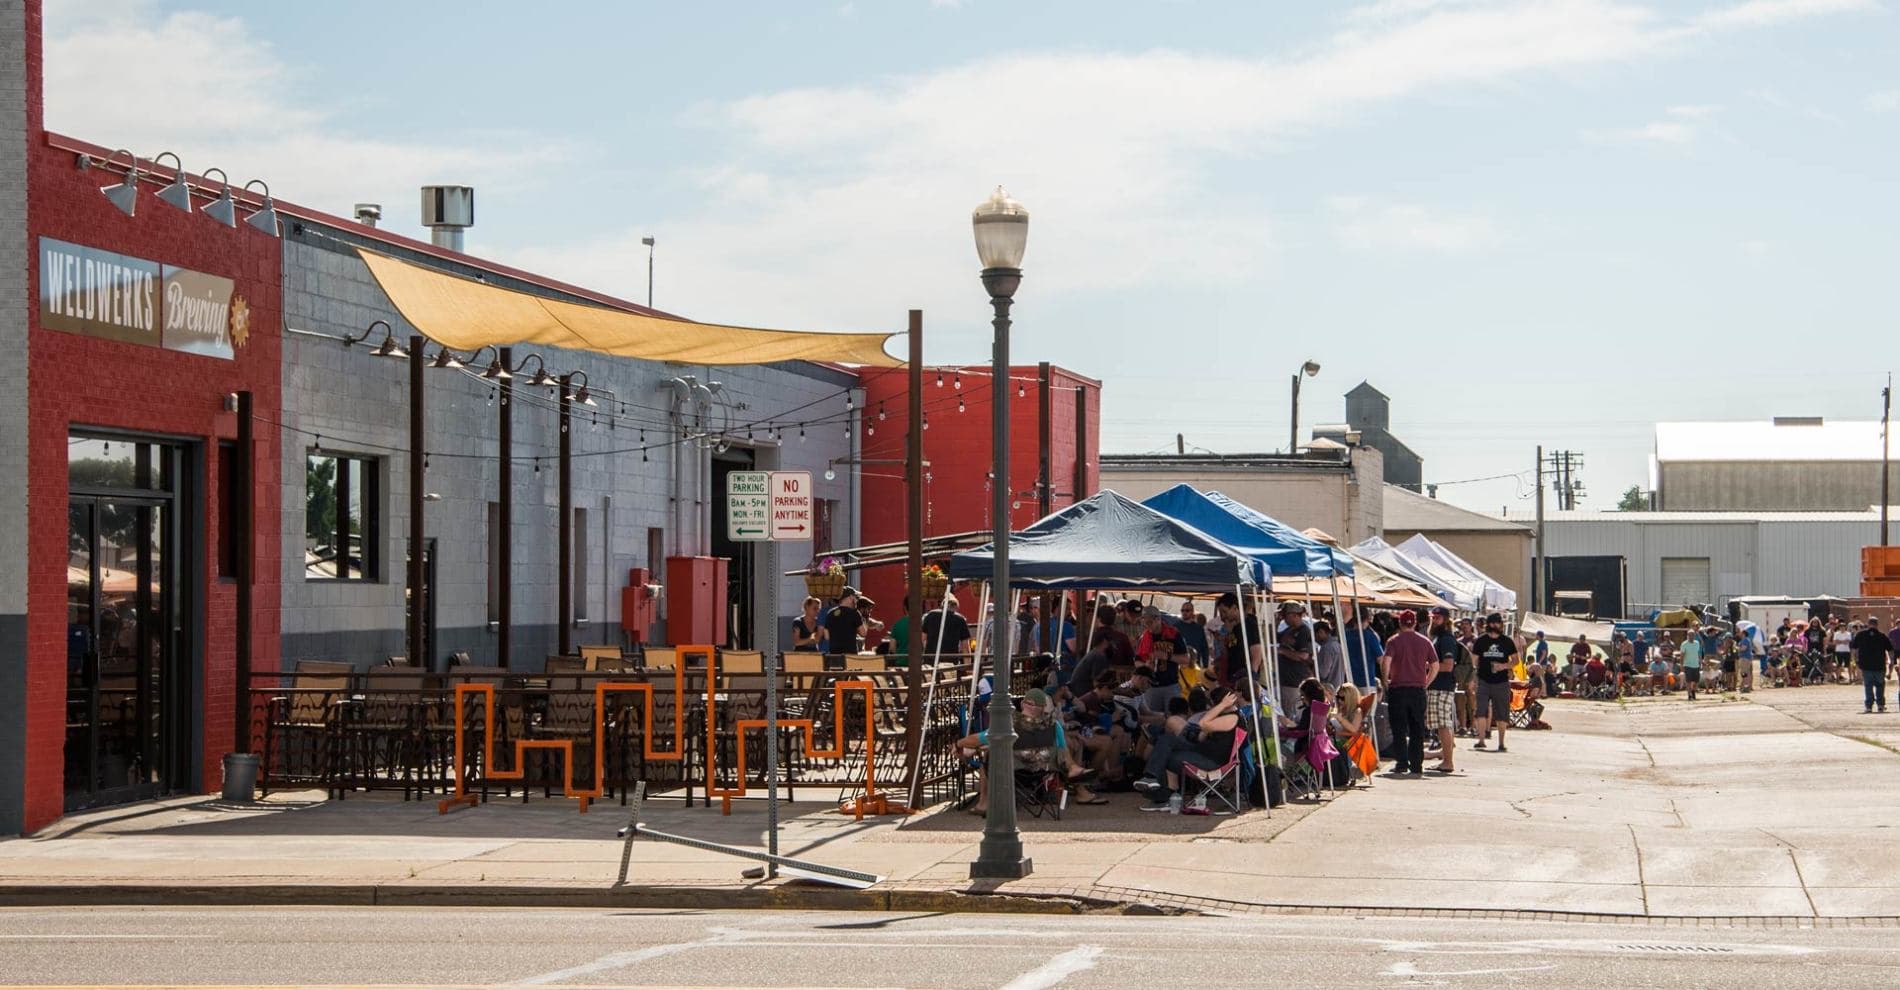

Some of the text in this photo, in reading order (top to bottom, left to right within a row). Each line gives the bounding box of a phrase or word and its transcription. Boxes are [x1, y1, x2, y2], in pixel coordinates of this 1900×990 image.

[47, 250, 228, 349] WELDWERKS Brewing
[733, 483, 765, 492] PARKING
[783, 479, 799, 493] NO
[774, 496, 808, 506] PARKING
[774, 510, 808, 520] ANYTIME
